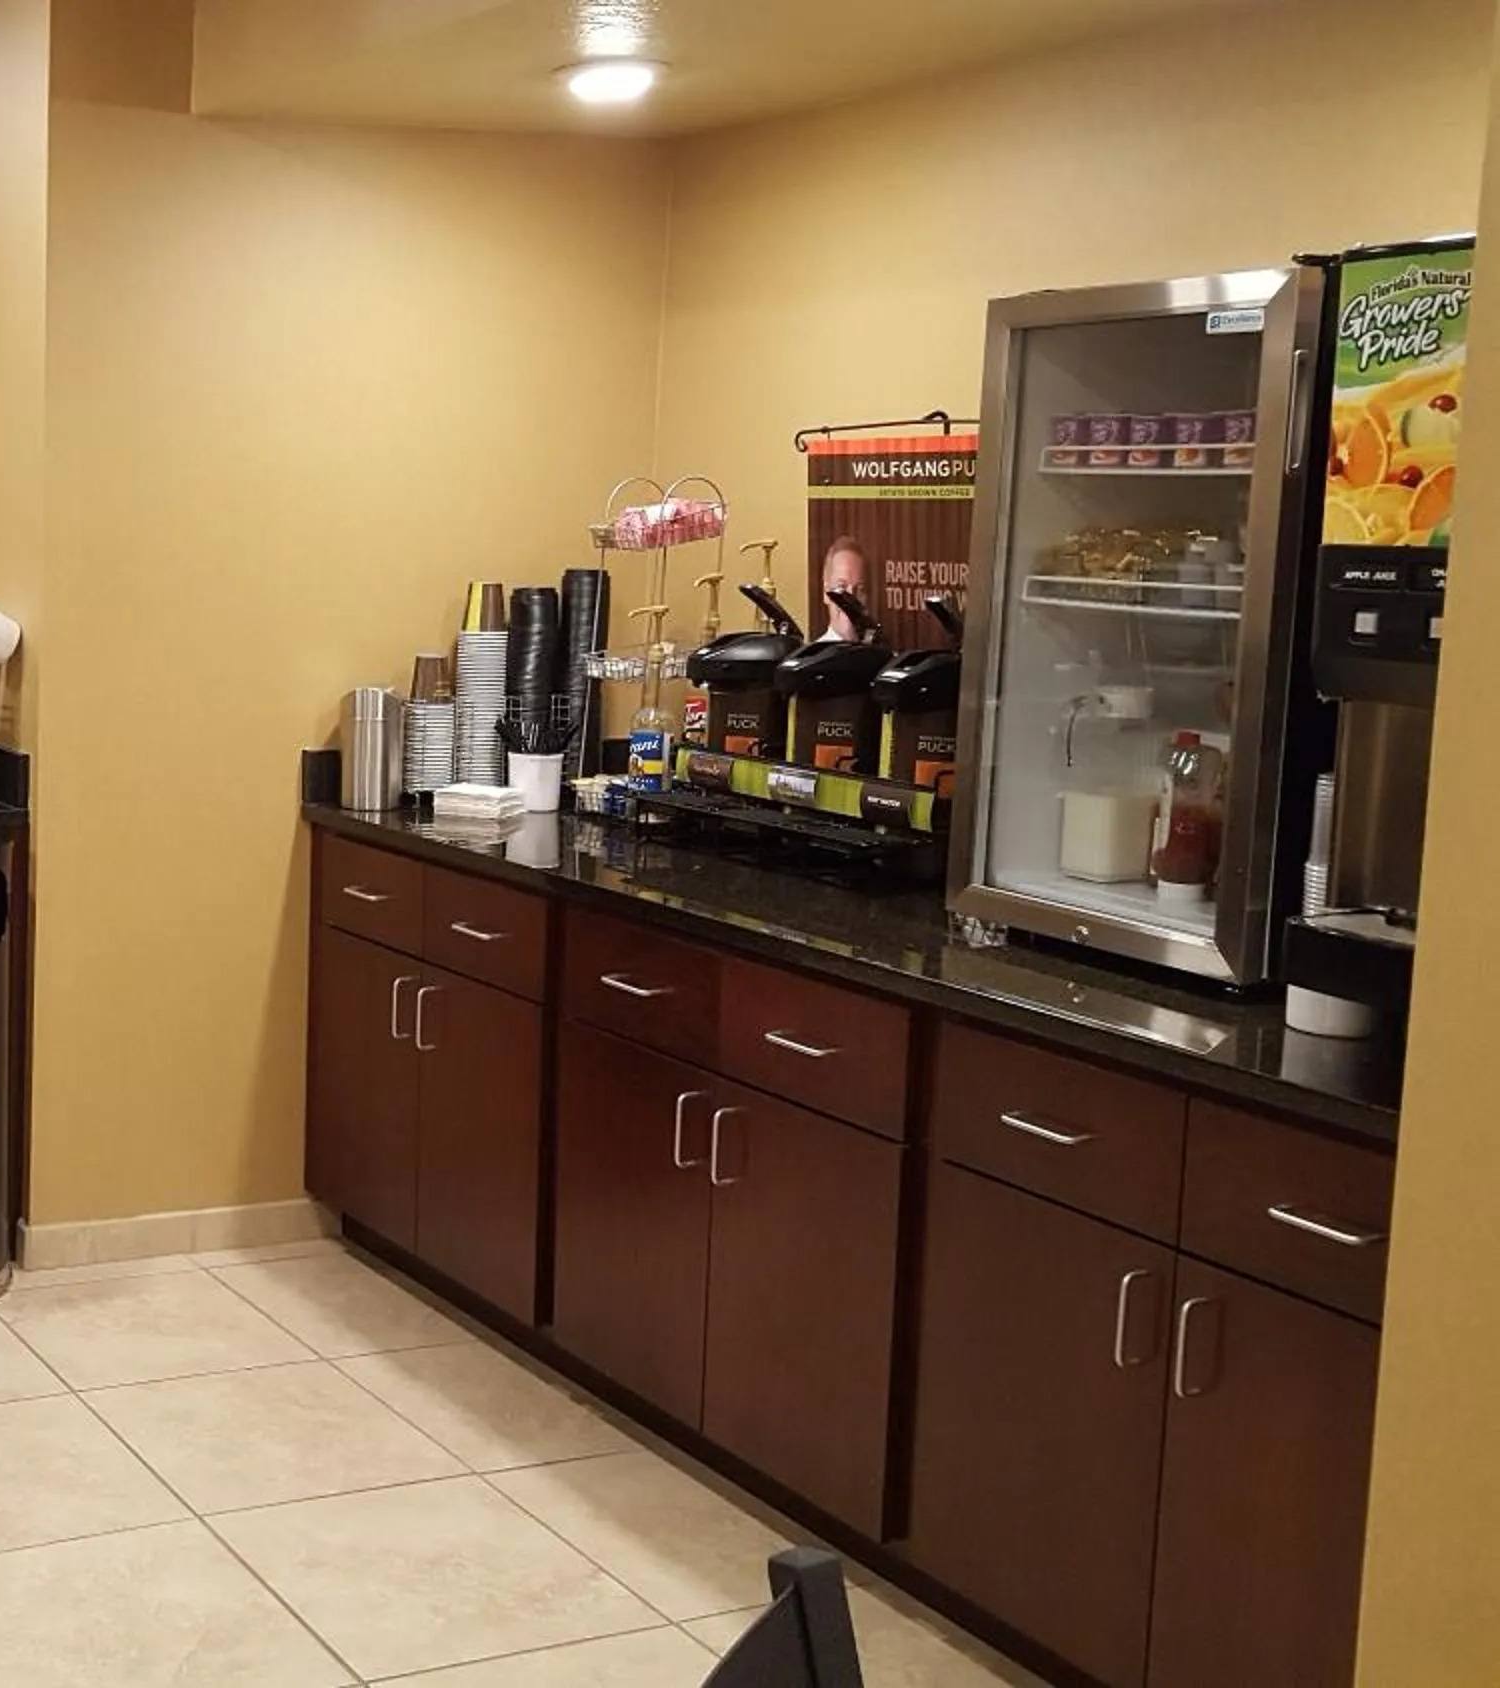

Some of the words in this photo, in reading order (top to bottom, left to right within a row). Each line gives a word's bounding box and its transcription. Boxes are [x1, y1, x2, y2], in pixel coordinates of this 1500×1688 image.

[1371, 273, 1419, 301] Florida's
[1421, 270, 1471, 286] Natural
[1340, 288, 1471, 339] Growers
[1357, 319, 1440, 369] Pride
[852, 460, 950, 478] WOLFGANG
[885, 560, 926, 584] RAISE
[929, 562, 970, 586] YOUR
[885, 587, 903, 610] TO
[727, 720, 760, 729] PUCK
[817, 727, 853, 737] PUCK
[917, 741, 956, 753] PUCK
